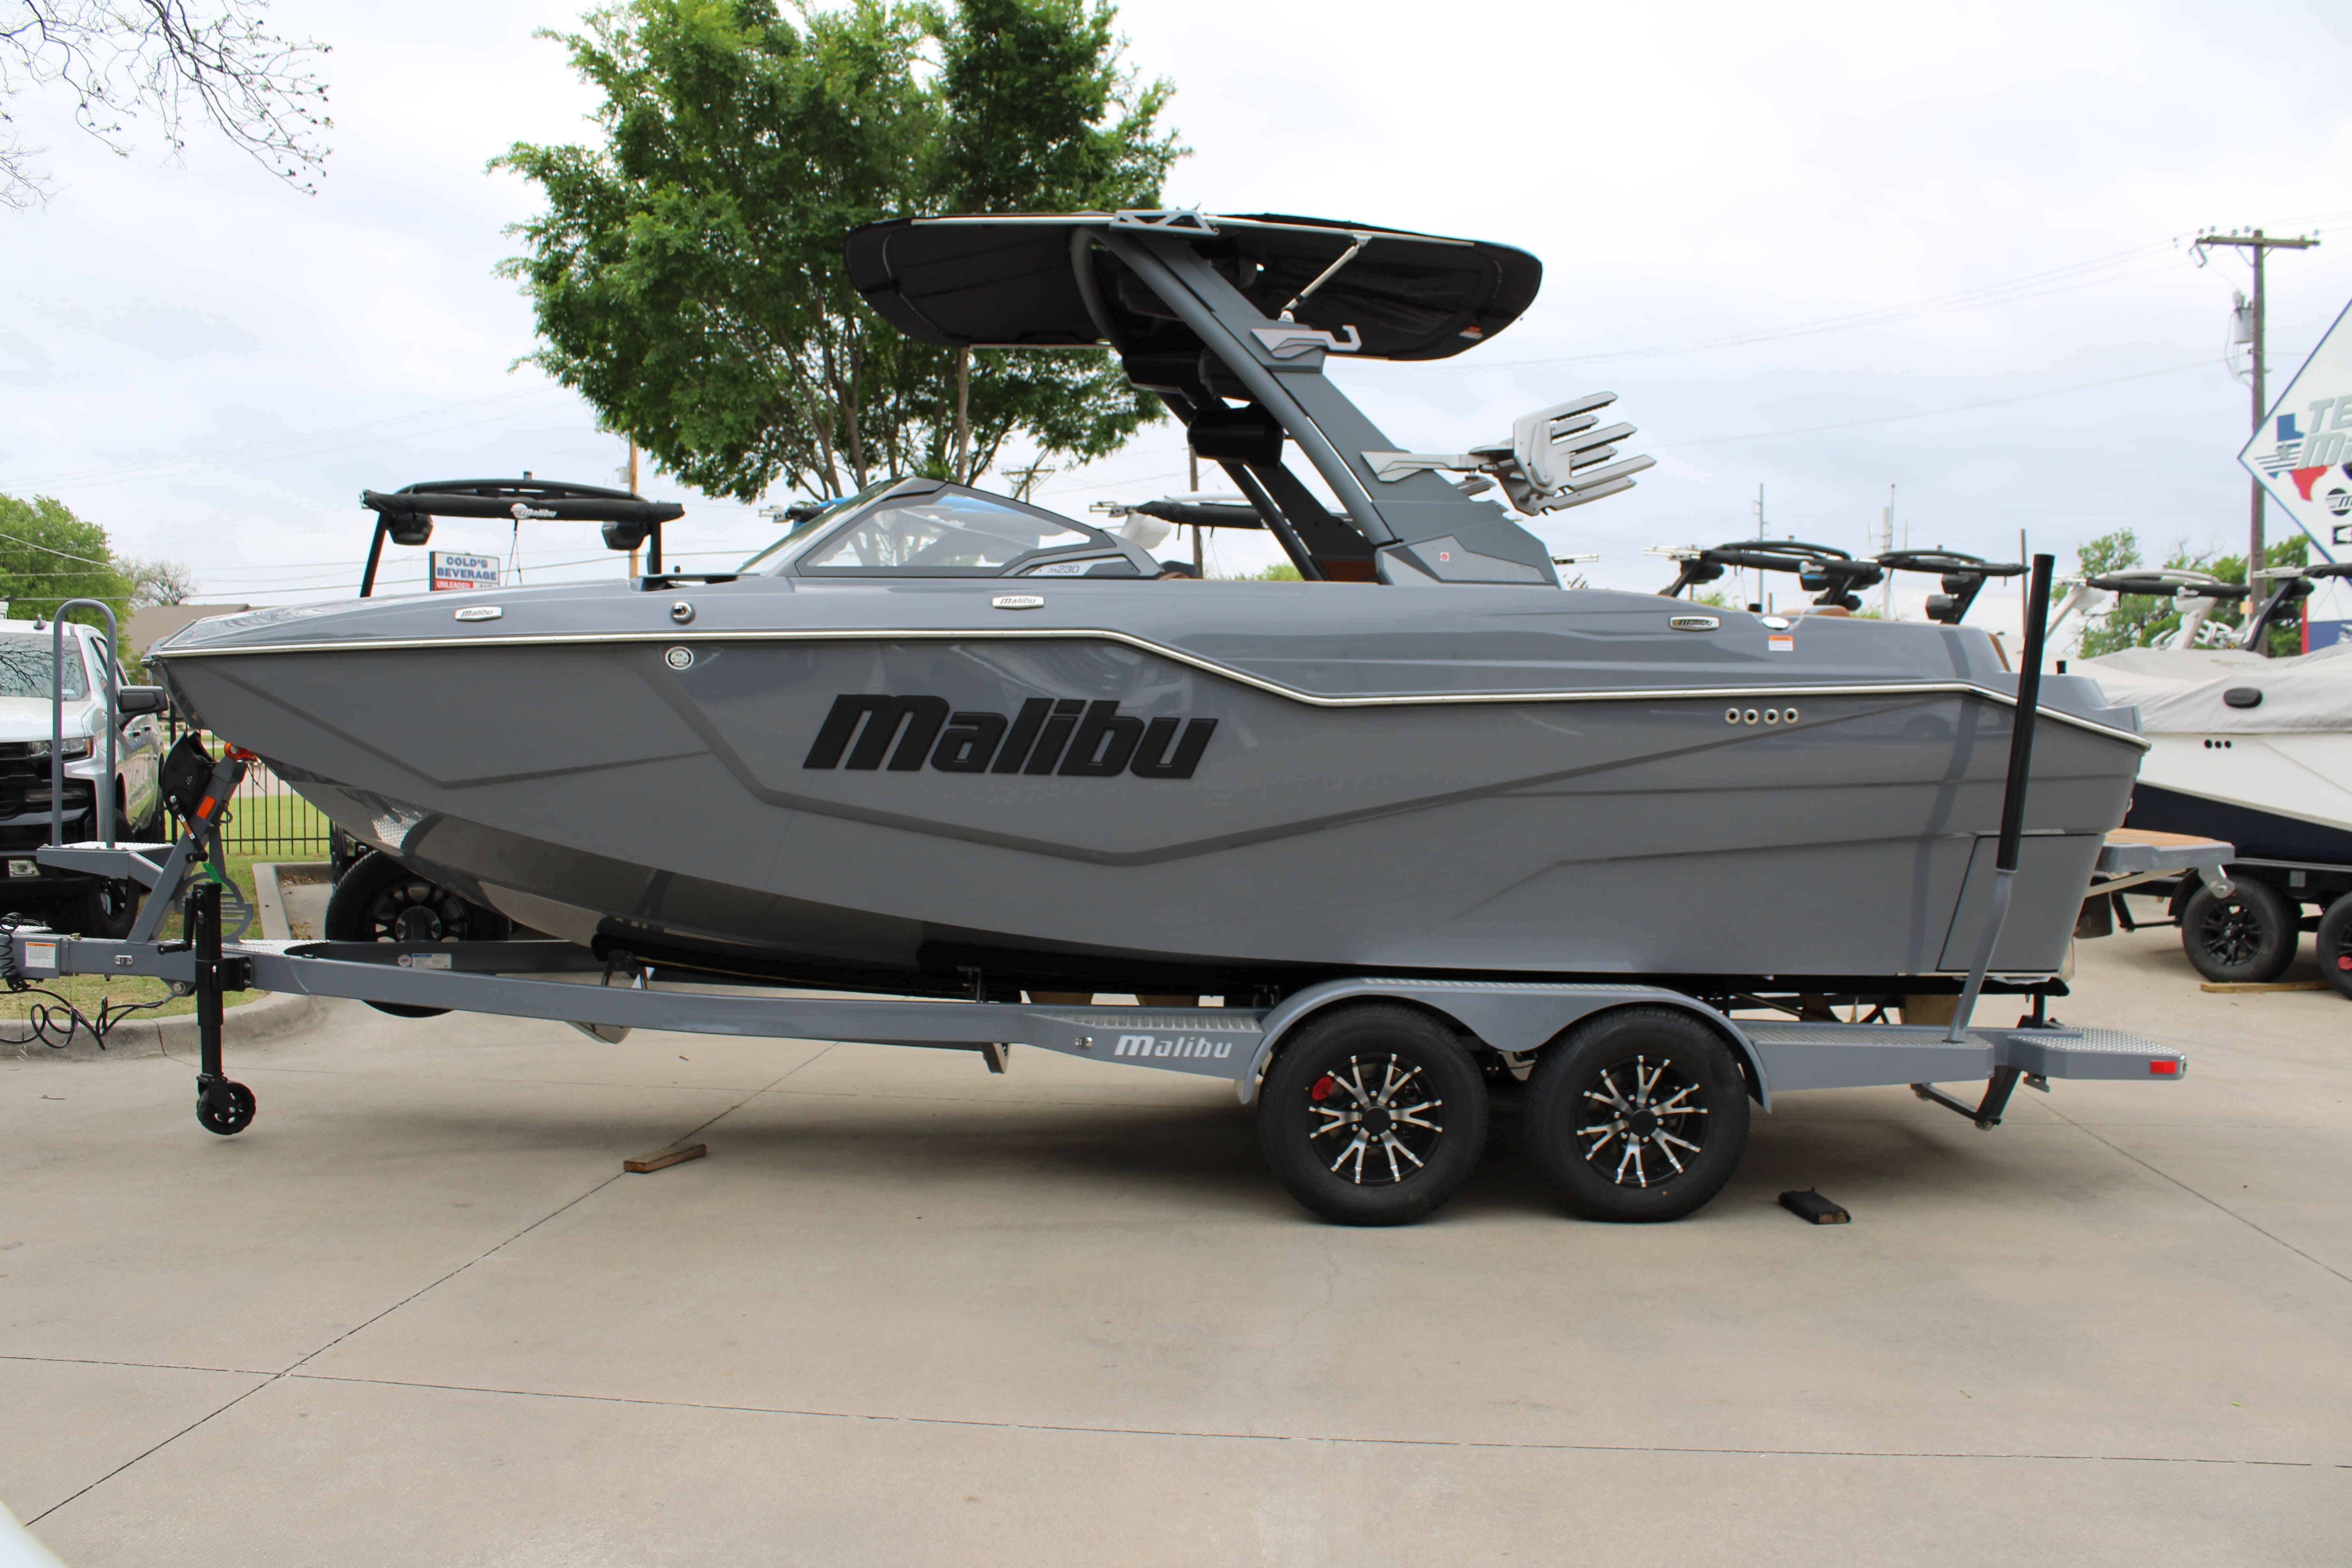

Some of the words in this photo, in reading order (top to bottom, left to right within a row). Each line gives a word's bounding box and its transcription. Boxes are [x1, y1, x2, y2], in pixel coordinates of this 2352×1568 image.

[446, 556, 488, 568] COLD'S
[437, 567, 497, 581] BEVERAGE
[437, 580, 471, 588] UNLEADED
[461, 609, 494, 617] Malibu
[802, 694, 1219, 779] Malibu
[1114, 1034, 1233, 1058] Malibu
